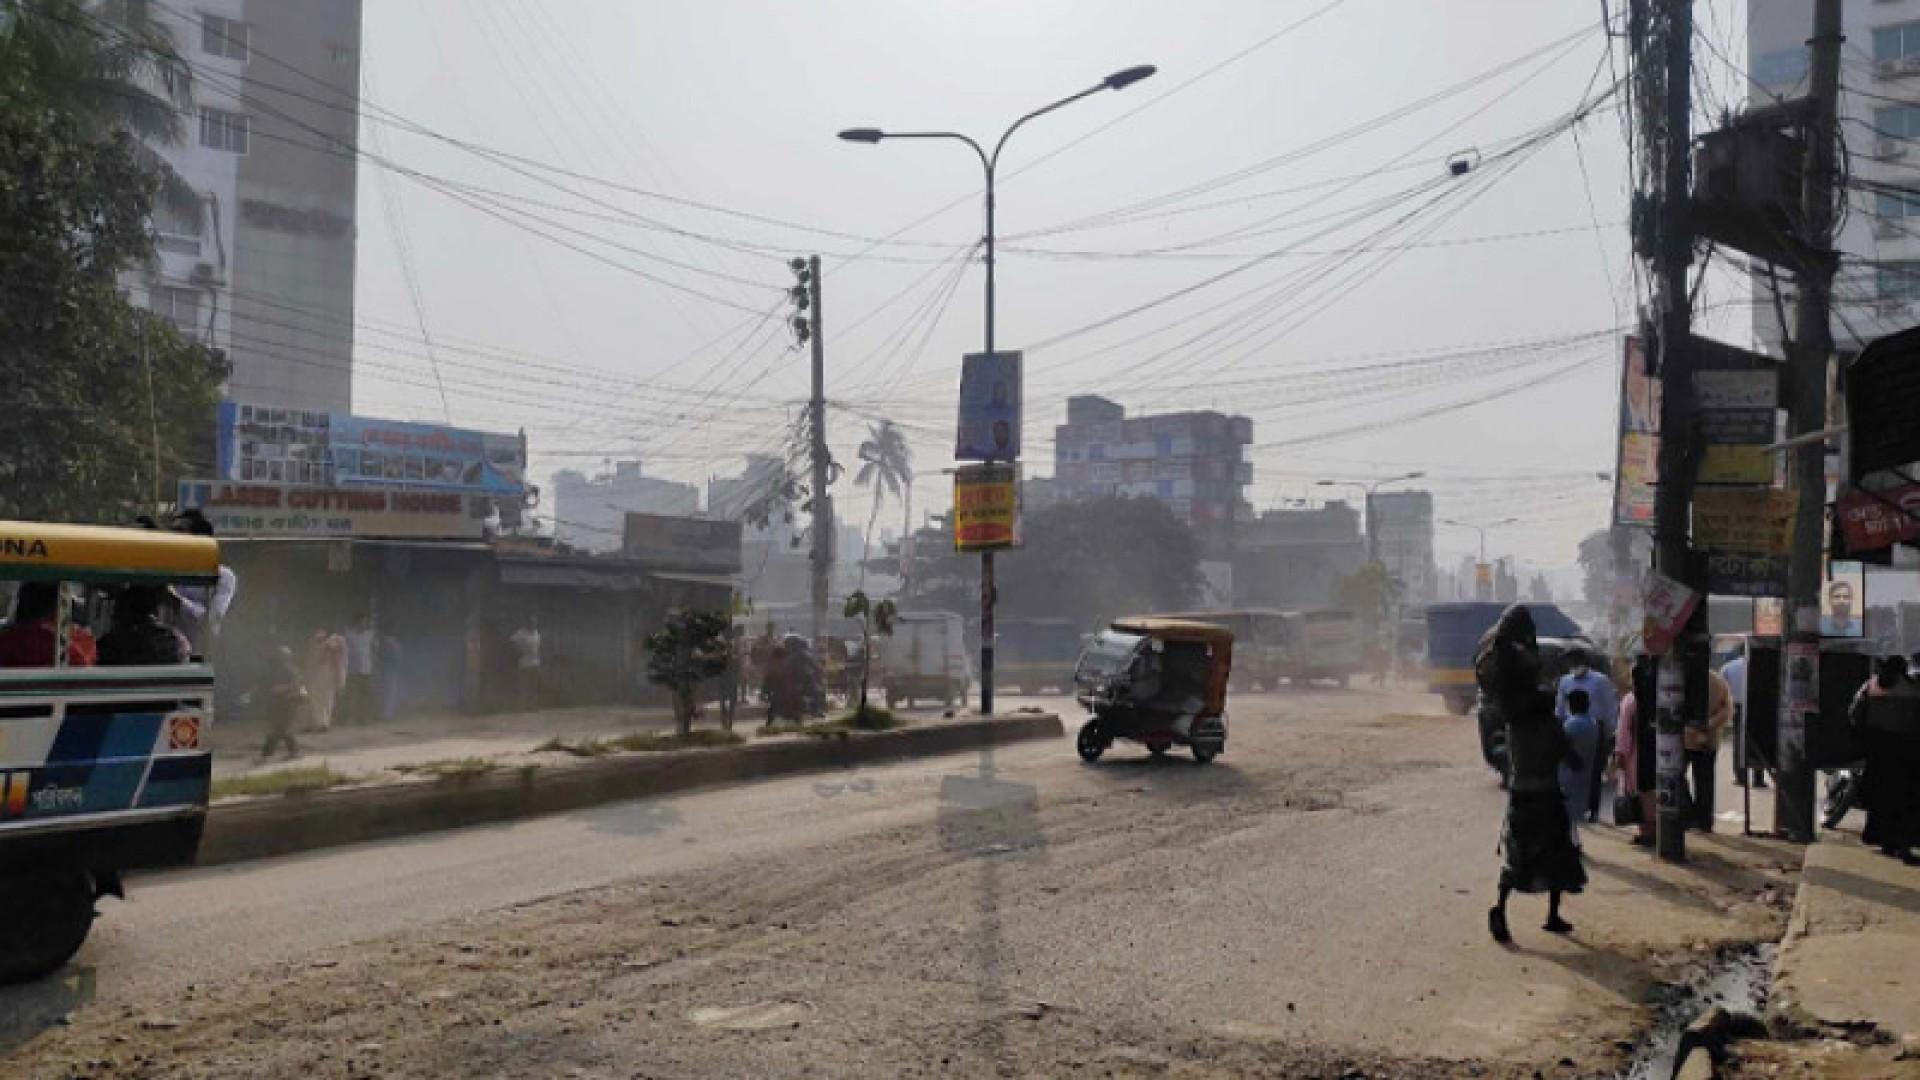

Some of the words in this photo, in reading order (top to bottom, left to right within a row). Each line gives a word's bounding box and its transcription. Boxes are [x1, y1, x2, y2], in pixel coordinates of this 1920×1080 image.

[287, 489, 387, 511] CUTTING
[391, 491, 463, 513] HOUSE
[0, 538, 48, 558] NA
